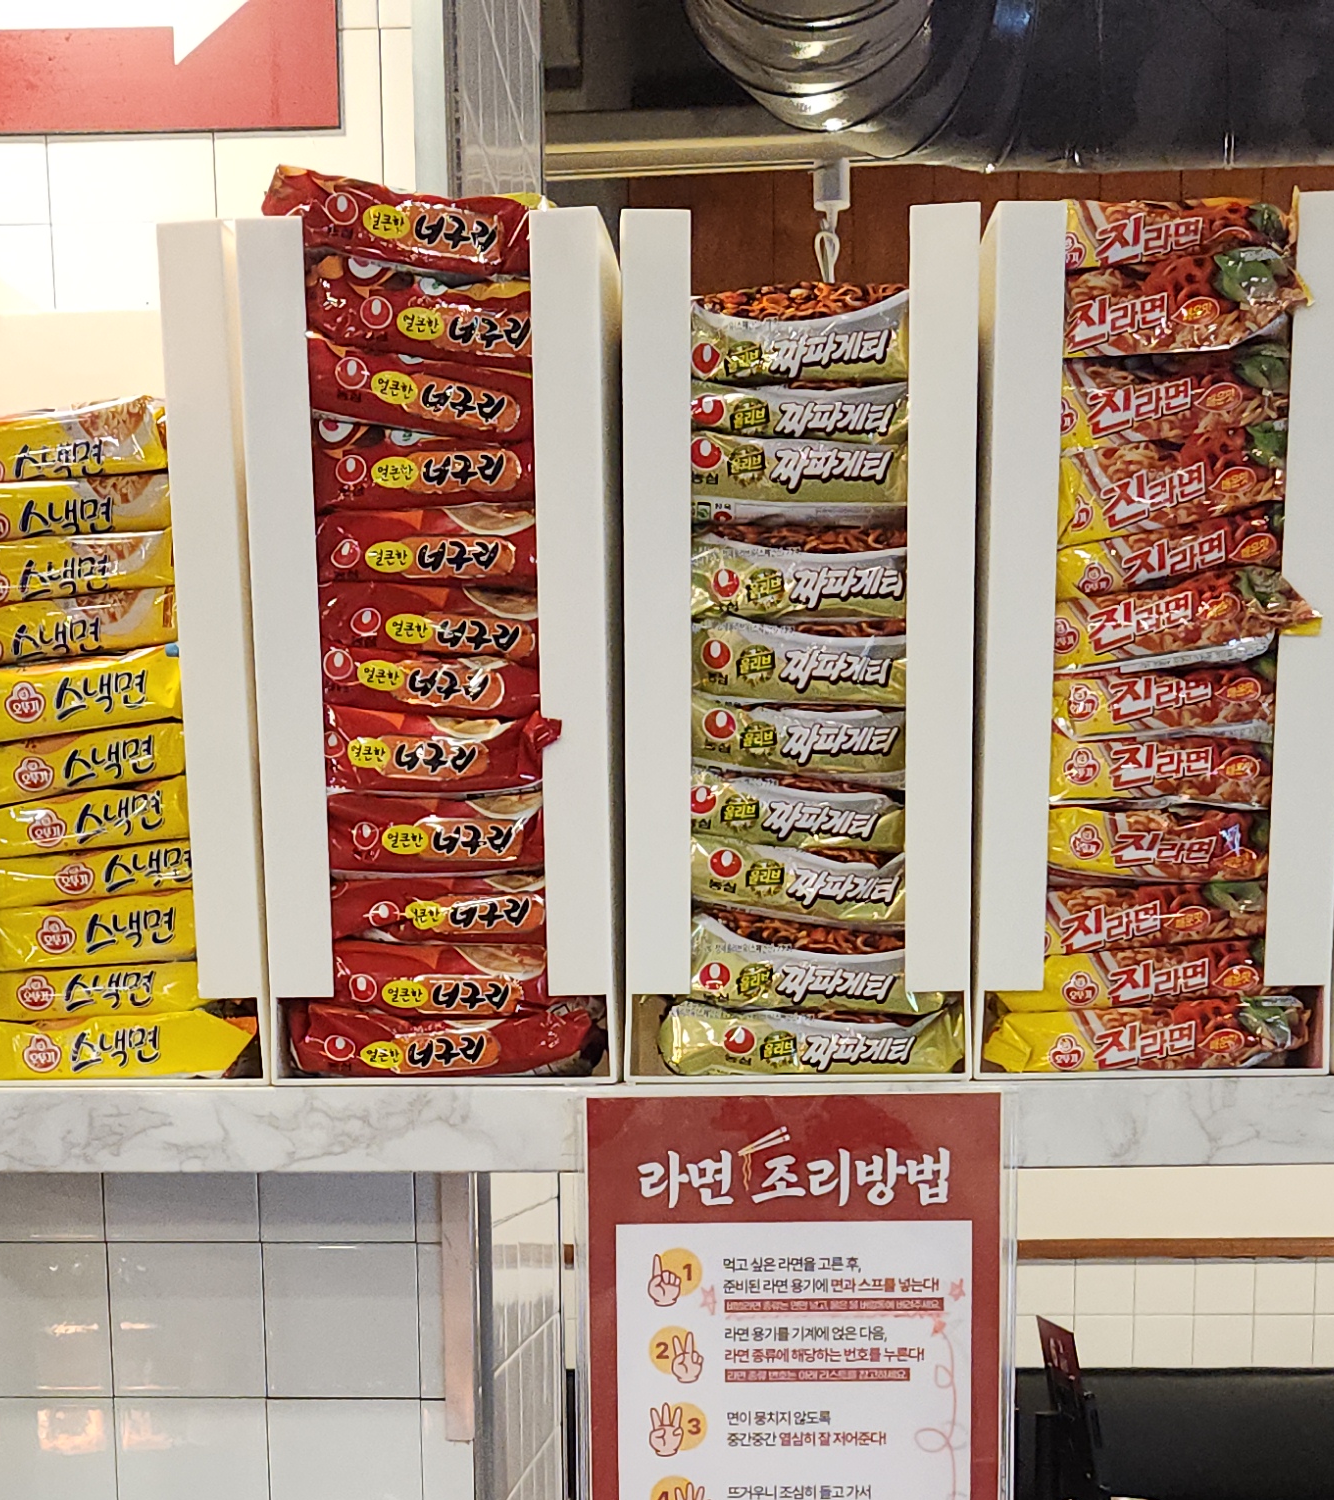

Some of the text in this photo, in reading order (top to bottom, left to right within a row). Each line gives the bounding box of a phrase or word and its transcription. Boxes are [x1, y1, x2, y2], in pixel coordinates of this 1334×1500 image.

[1095, 212, 1203, 268] 진라면
[449, 315, 531, 349] 너구리
[1065, 292, 1168, 352] 진라면
[769, 328, 893, 379] 짜파게티
[377, 377, 505, 421] 얼큰한 너구리
[775, 402, 896, 437] 짜파게티
[1087, 378, 1192, 439] 진라면
[422, 453, 505, 487] 너구리
[771, 447, 894, 492] 짜파게티
[19, 496, 115, 535] 스낵면
[1101, 462, 1206, 532] 진라면
[20, 554, 111, 598] 스낵면
[417, 541, 498, 573] 너구리
[790, 566, 905, 609] 짜파게티
[12, 617, 103, 658] 스낵면
[391, 619, 520, 651] 얼큰한 너구리
[1088, 590, 1193, 655] 진라면
[363, 667, 400, 685] 얼큰한
[781, 647, 893, 692] 짜파게티
[54, 669, 148, 721] 스낵면
[1108, 676, 1212, 724] 진라면
[63, 734, 155, 786] 스낵면
[351, 741, 478, 773] 얼큰한 너구리
[781, 723, 900, 766] 짜파게티
[1110, 743, 1213, 790] 진라면
[75, 789, 163, 845] 스낵면
[723, 801, 879, 841] 올리브 짜파게티
[387, 826, 514, 855] 얼큰한 너구리
[1110, 831, 1217, 868] 진라면
[104, 847, 193, 893] 스낵면
[748, 866, 902, 909] 올리브 짜파게티
[85, 907, 176, 954] 스낵면
[449, 897, 529, 928] 너구리
[1061, 900, 1160, 953] 진라면
[64, 970, 155, 1012] 스낵면
[387, 981, 510, 1011] 얼큰한 너구리
[776, 963, 896, 1004] 짜파게티
[1109, 958, 1209, 1006] 진라면
[71, 1025, 160, 1072] 스낵면
[407, 1033, 485, 1067] 너구리
[802, 1034, 916, 1072] 짜파게티
[1093, 1020, 1196, 1070] 진라면
[638, 1148, 950, 1208] 라면 조리방법
[683, 1264, 692, 1281] 1
[723, 1257, 861, 1273] 먹고 싶은 라면을 고른 후,
[723, 1278, 939, 1294] 준비된 라면 용기에 면과 스프를 넣는다!
[656, 1342, 669, 1359] 2
[724, 1327, 887, 1342] 라면 용기를 기계에 얹은 다음,
[724, 1348, 925, 1363] 라면 종류에 해당하는 번호를 누른다!
[688, 1418, 701, 1435] 3
[727, 1411, 831, 1425] 면이 뭉치지 않도록
[727, 1432, 886, 1446] 중간중간 열심히 잘 저어준다!
[728, 1485, 871, 1500] 뜨거우니 조심히 들고 가서
